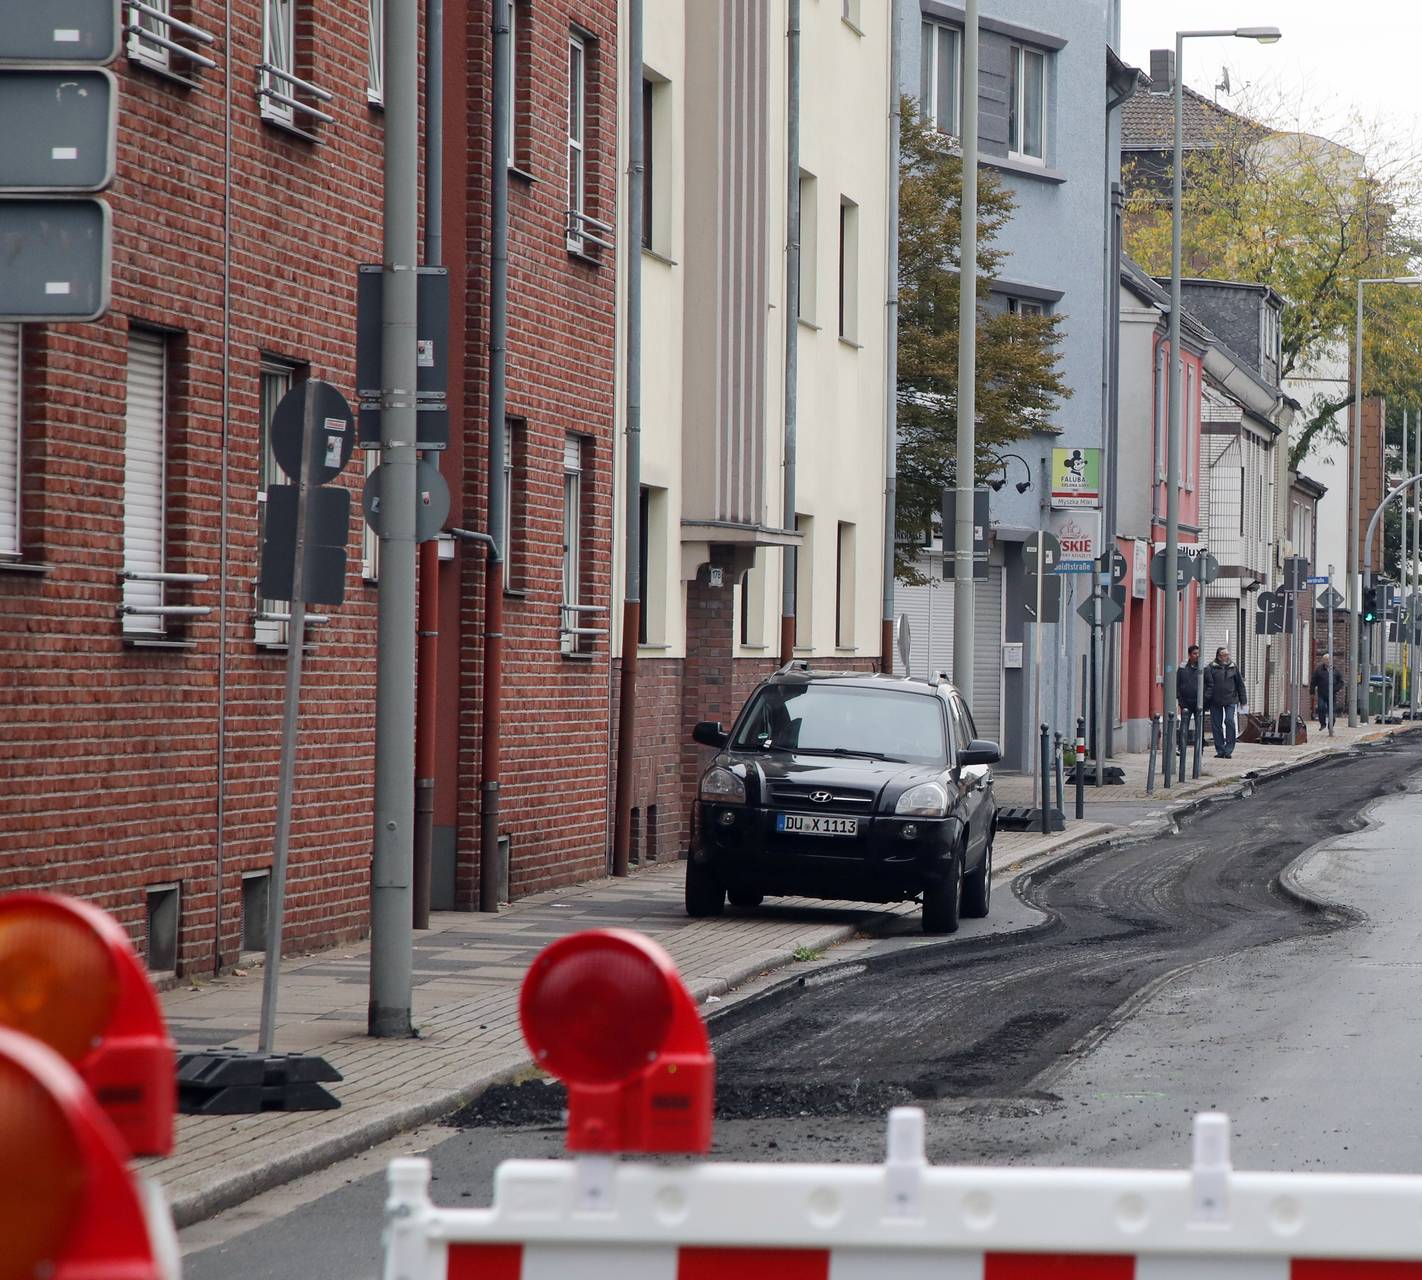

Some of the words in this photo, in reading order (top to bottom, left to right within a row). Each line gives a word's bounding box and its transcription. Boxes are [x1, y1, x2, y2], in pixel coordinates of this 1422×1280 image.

[1060, 540, 1092, 552] SKIE
[786, 817, 803, 830] DU
[811, 819, 820, 831] X
[823, 820, 856, 833] 1113
